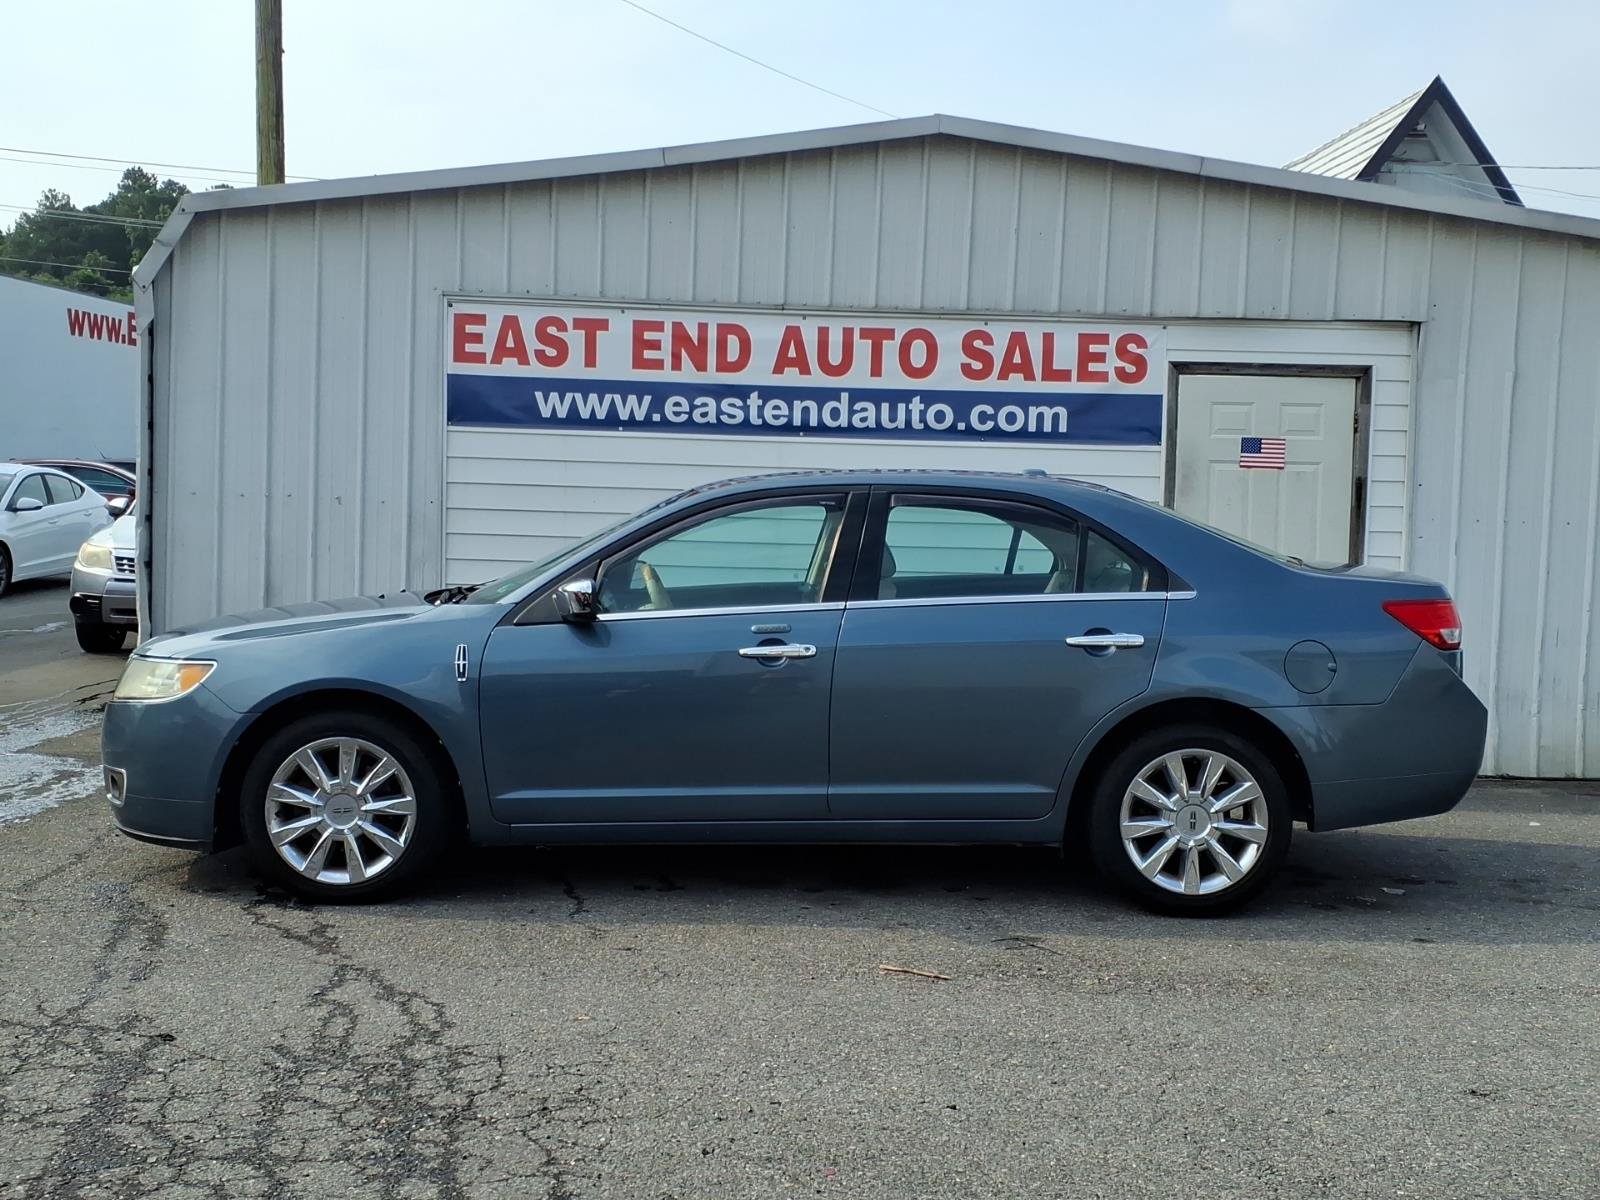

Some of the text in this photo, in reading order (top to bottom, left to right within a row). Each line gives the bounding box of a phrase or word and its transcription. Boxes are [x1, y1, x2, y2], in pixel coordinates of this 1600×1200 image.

[452, 312, 1149, 384] EAST END AUTO SALES
[534, 391, 1068, 434] www.eastendauto.com
